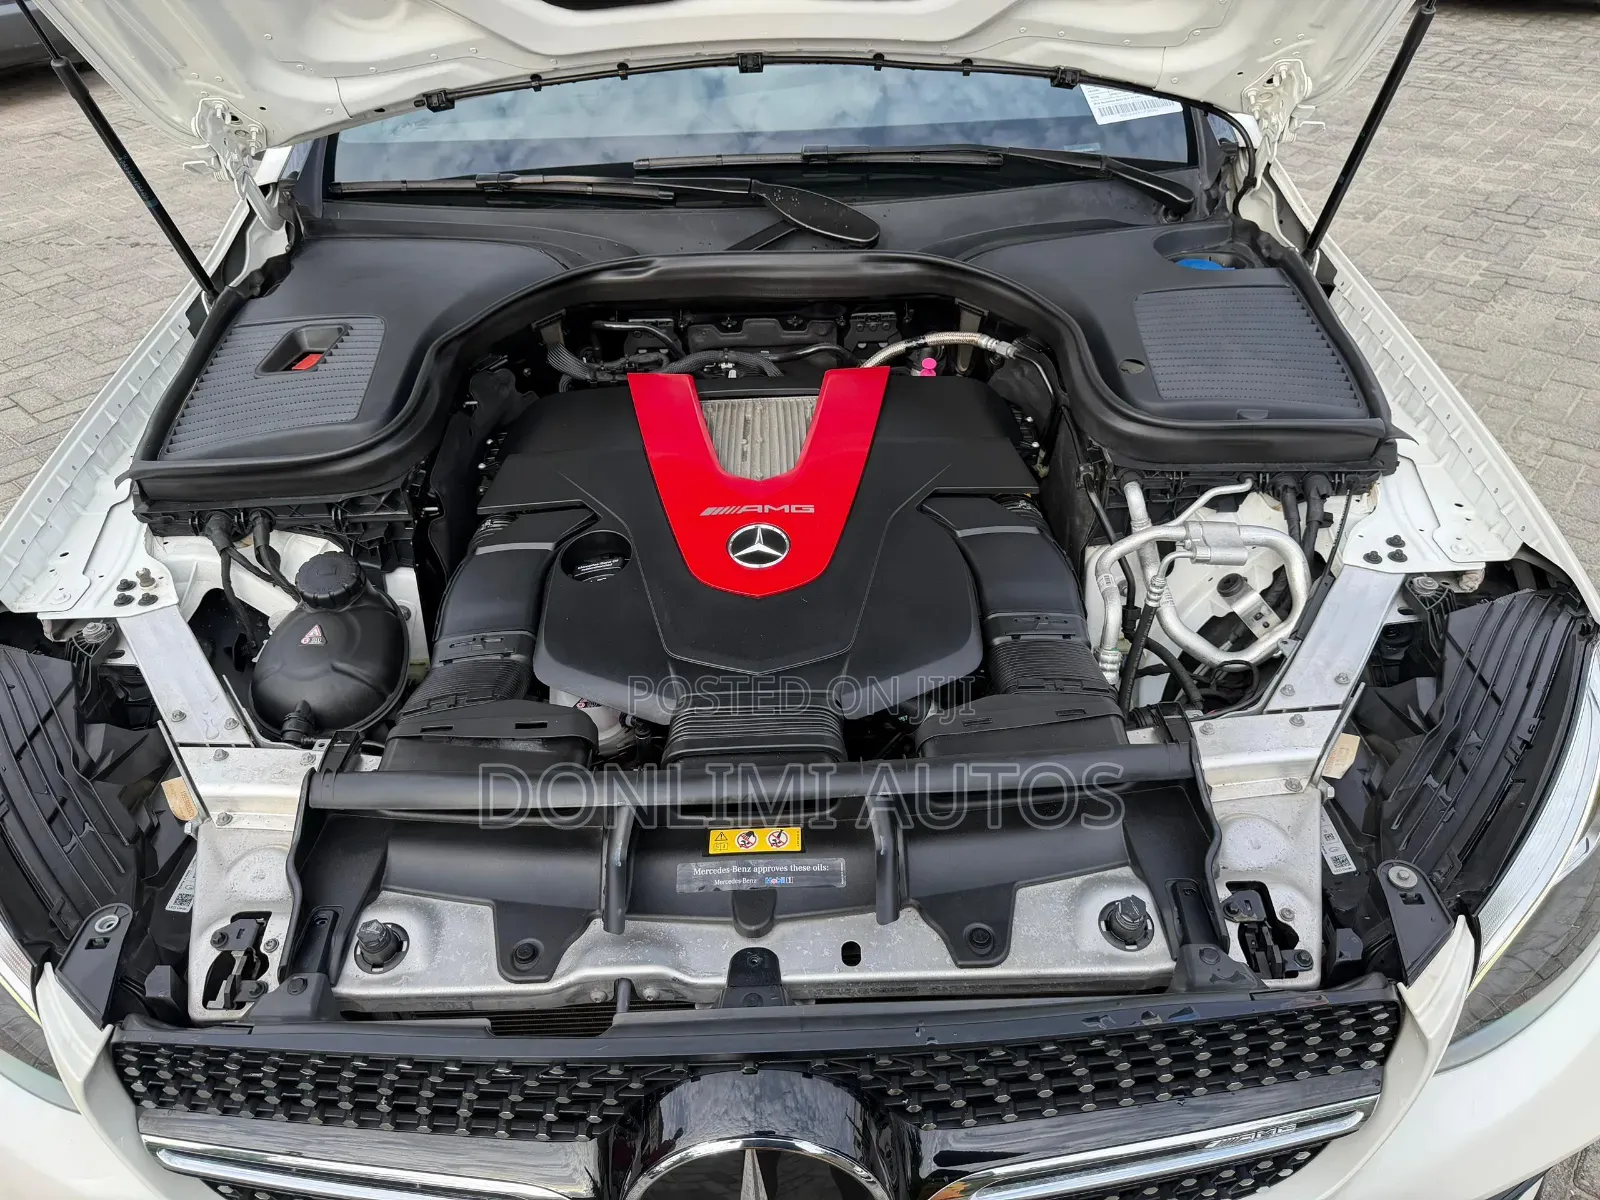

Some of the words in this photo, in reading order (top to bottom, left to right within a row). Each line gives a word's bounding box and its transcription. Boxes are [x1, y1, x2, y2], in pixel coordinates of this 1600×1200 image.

[737, 504, 815, 514] AMG
[693, 865, 752, 876] Mercedes-Benz
[753, 865, 788, 875] approves
[790, 864, 811, 872] these
[812, 863, 829, 872] oils:
[714, 877, 757, 886] Mercedes-Benz
